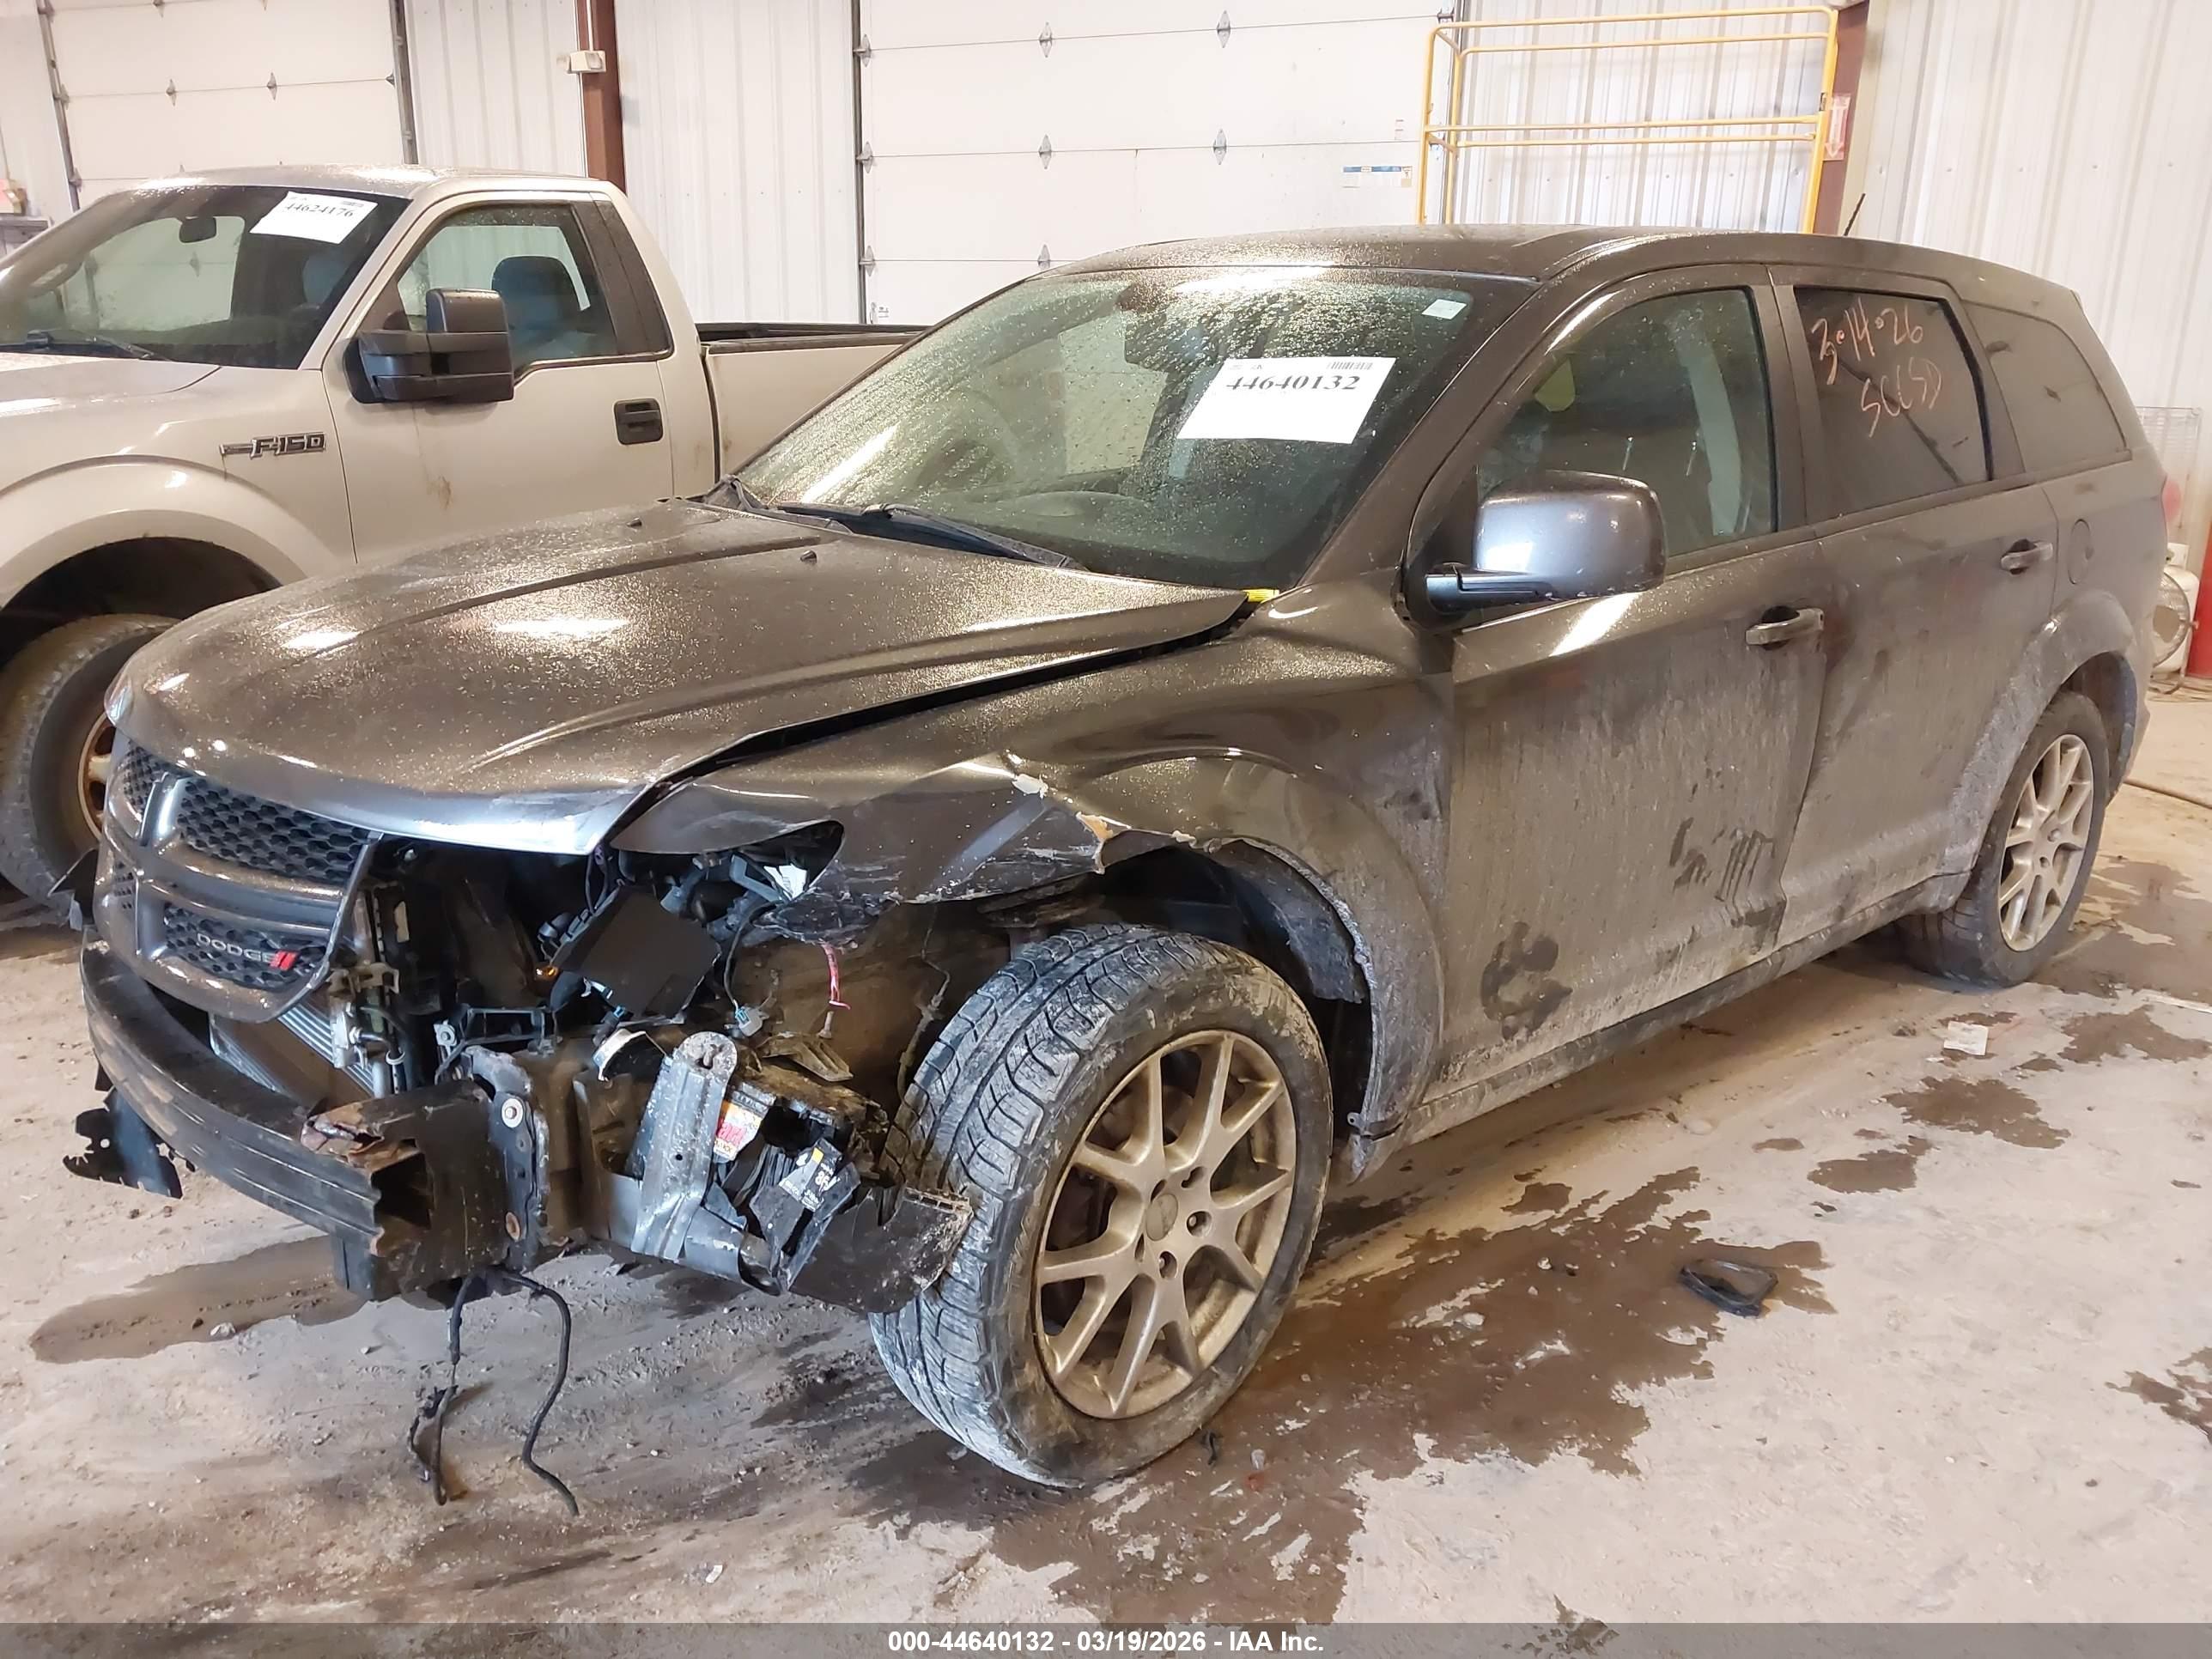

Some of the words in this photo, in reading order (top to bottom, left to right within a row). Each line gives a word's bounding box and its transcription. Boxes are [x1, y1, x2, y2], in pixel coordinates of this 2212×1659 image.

[284, 202, 354, 217] 44624176
[1225, 375, 1361, 391] 44640132
[250, 432, 326, 460] F-150
[197, 933, 276, 963] DODGE
